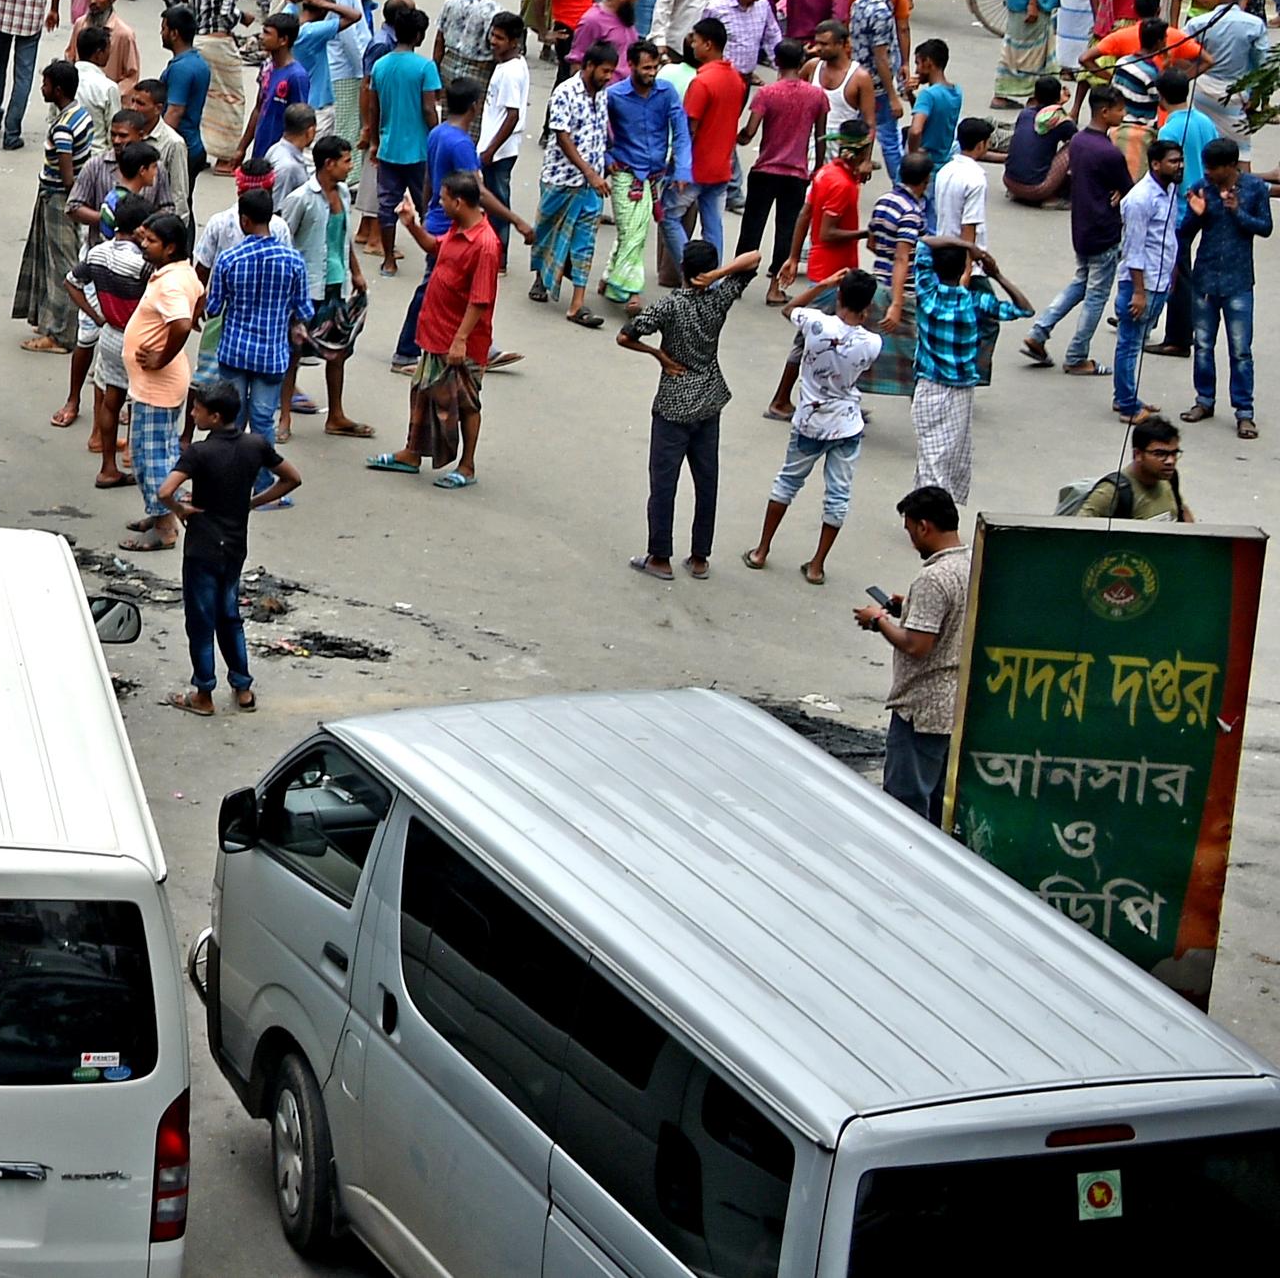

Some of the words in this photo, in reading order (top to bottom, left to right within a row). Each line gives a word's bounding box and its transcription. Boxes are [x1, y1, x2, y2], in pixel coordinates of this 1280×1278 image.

[985, 647, 1096, 722] সদর
[1108, 650, 1220, 729] দপ্তর
[971, 749, 1195, 808] আনসার
[1052, 821, 1096, 858] ও
